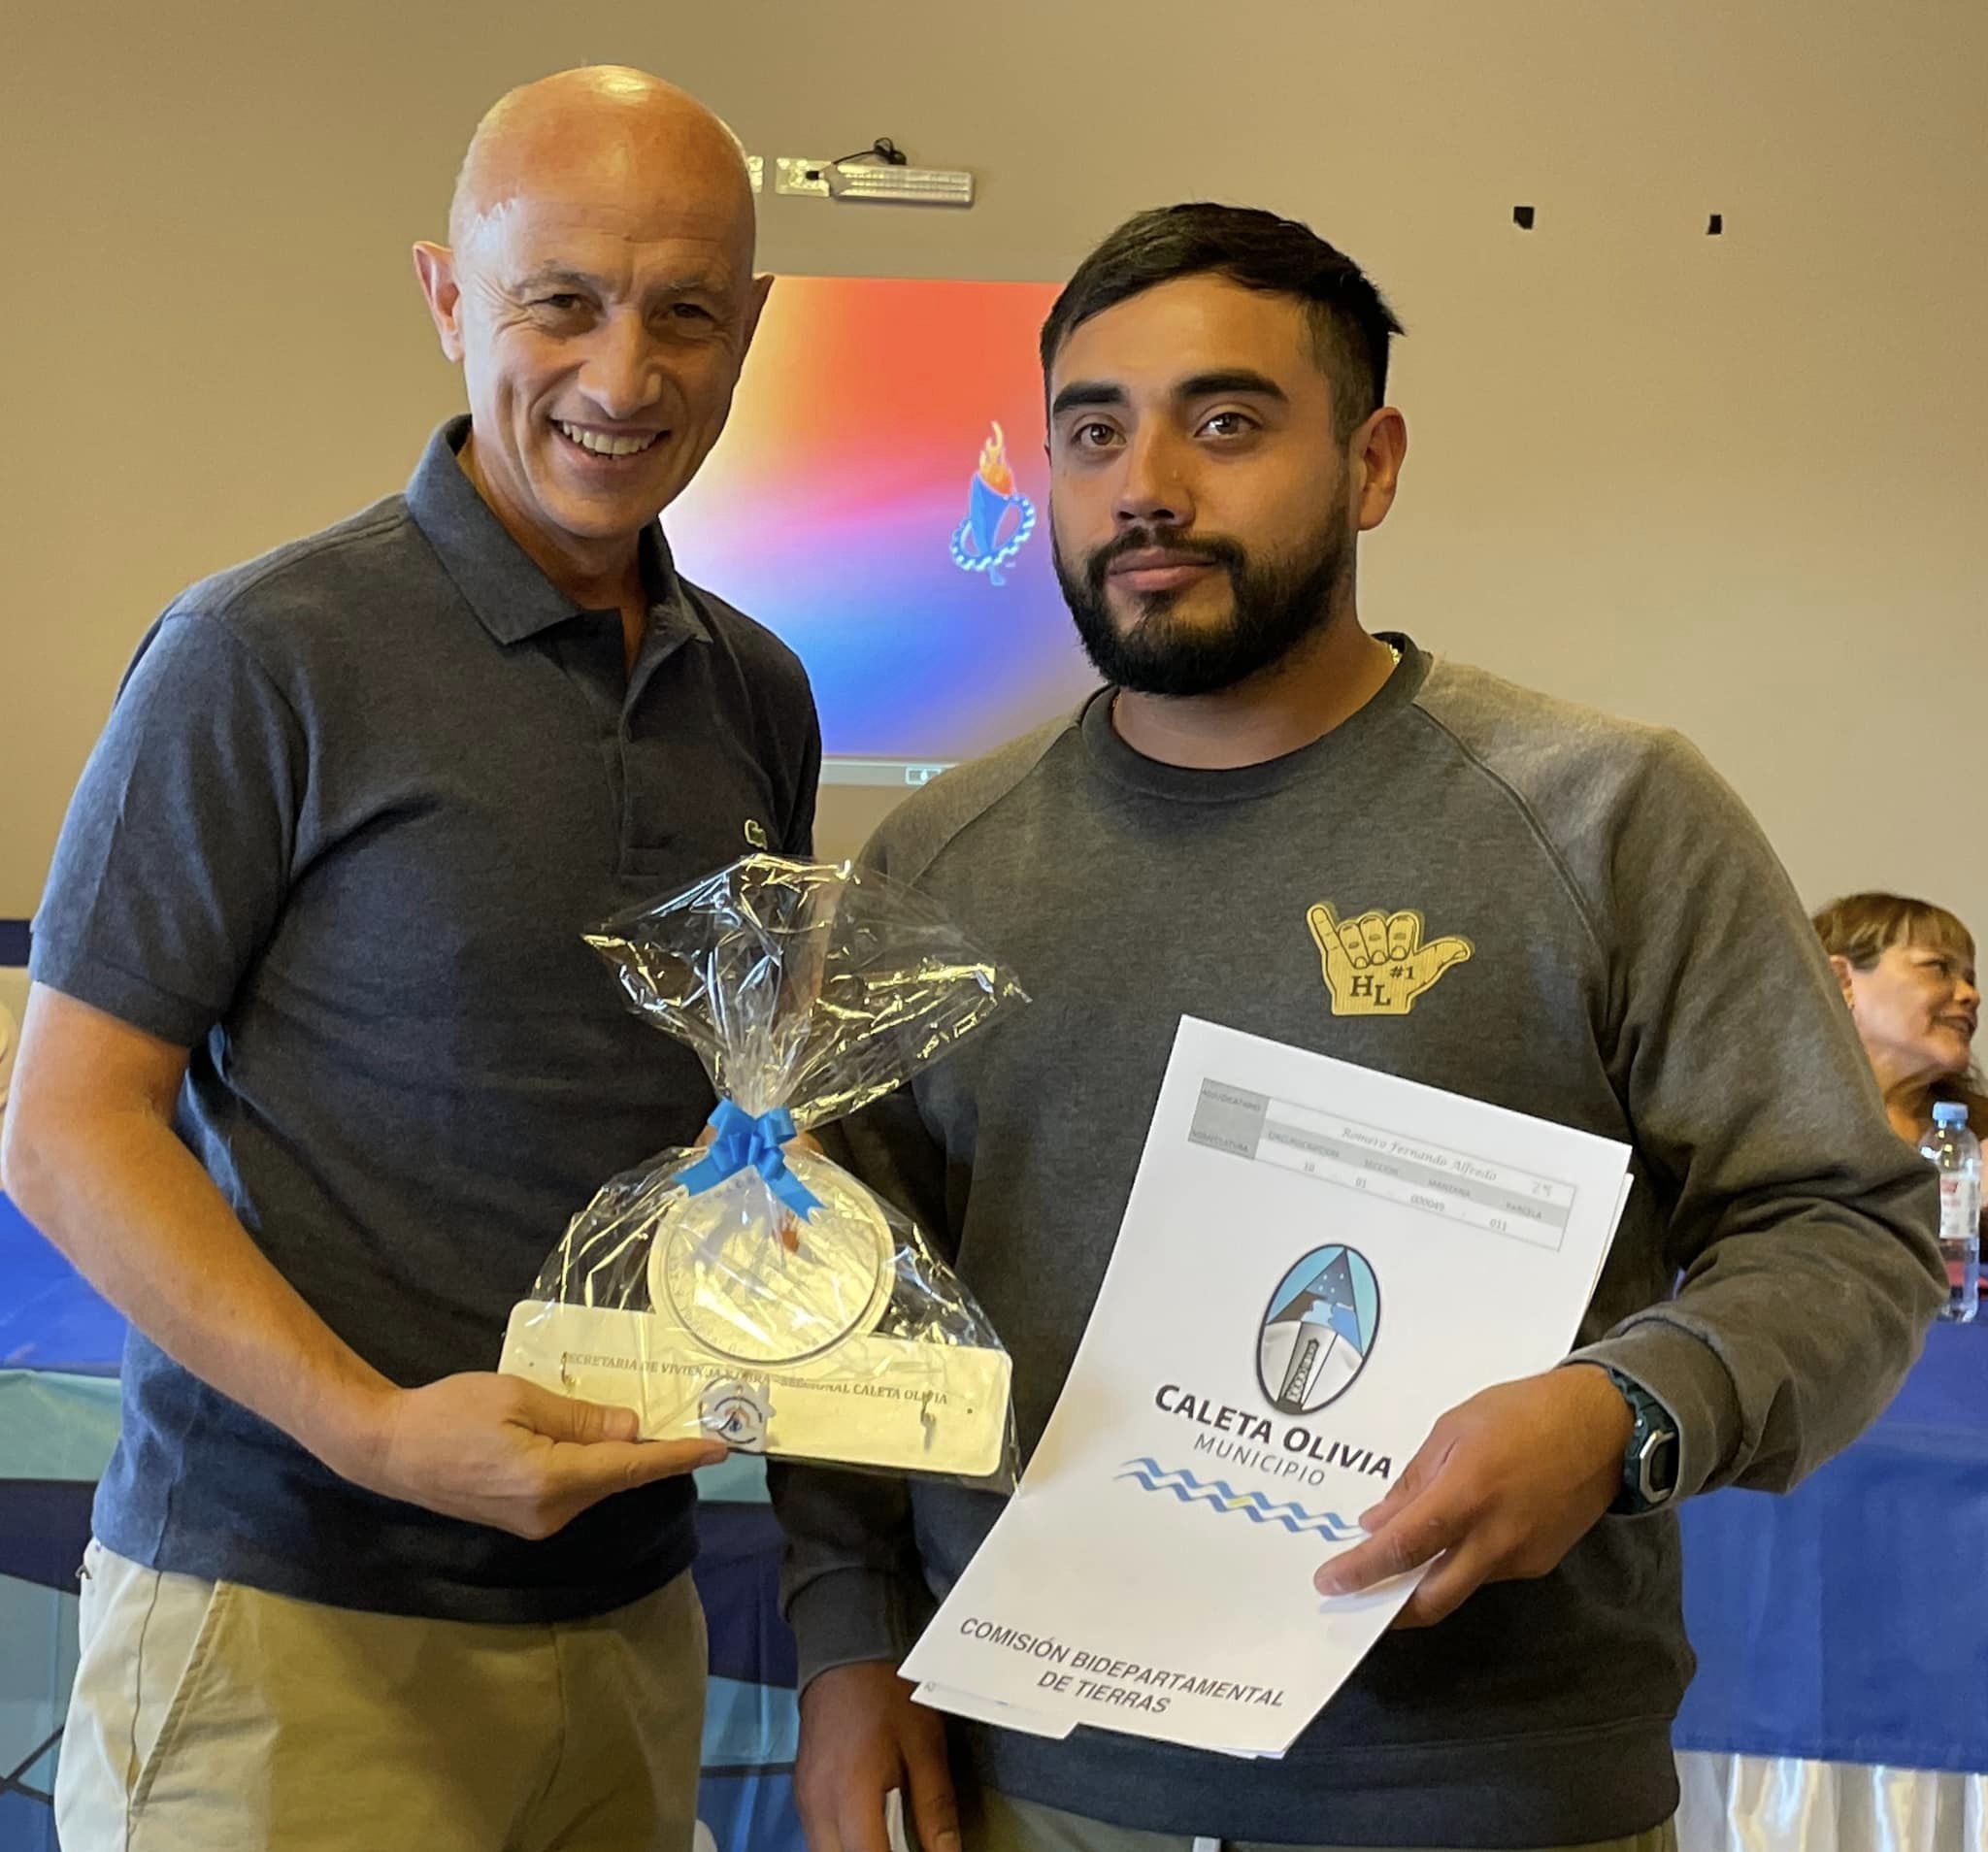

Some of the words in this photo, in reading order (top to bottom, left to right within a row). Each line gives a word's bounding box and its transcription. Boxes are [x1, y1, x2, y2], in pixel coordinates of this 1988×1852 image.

[1452, 1160, 1498, 1182] Alfredo
[853, 1383, 901, 1401] CALETA
[1155, 1384, 1273, 1444] CALETA
[1282, 1427, 1393, 1479] OLIVIA
[1193, 1433, 1325, 1487] MUNICIPIO
[960, 1617, 1069, 1664] COMISIÓN
[1071, 1650, 1285, 1708] BIDEPARTAMENTAL
[1037, 1670, 1073, 1692] DE
[1078, 1677, 1171, 1714] TIERRAS
